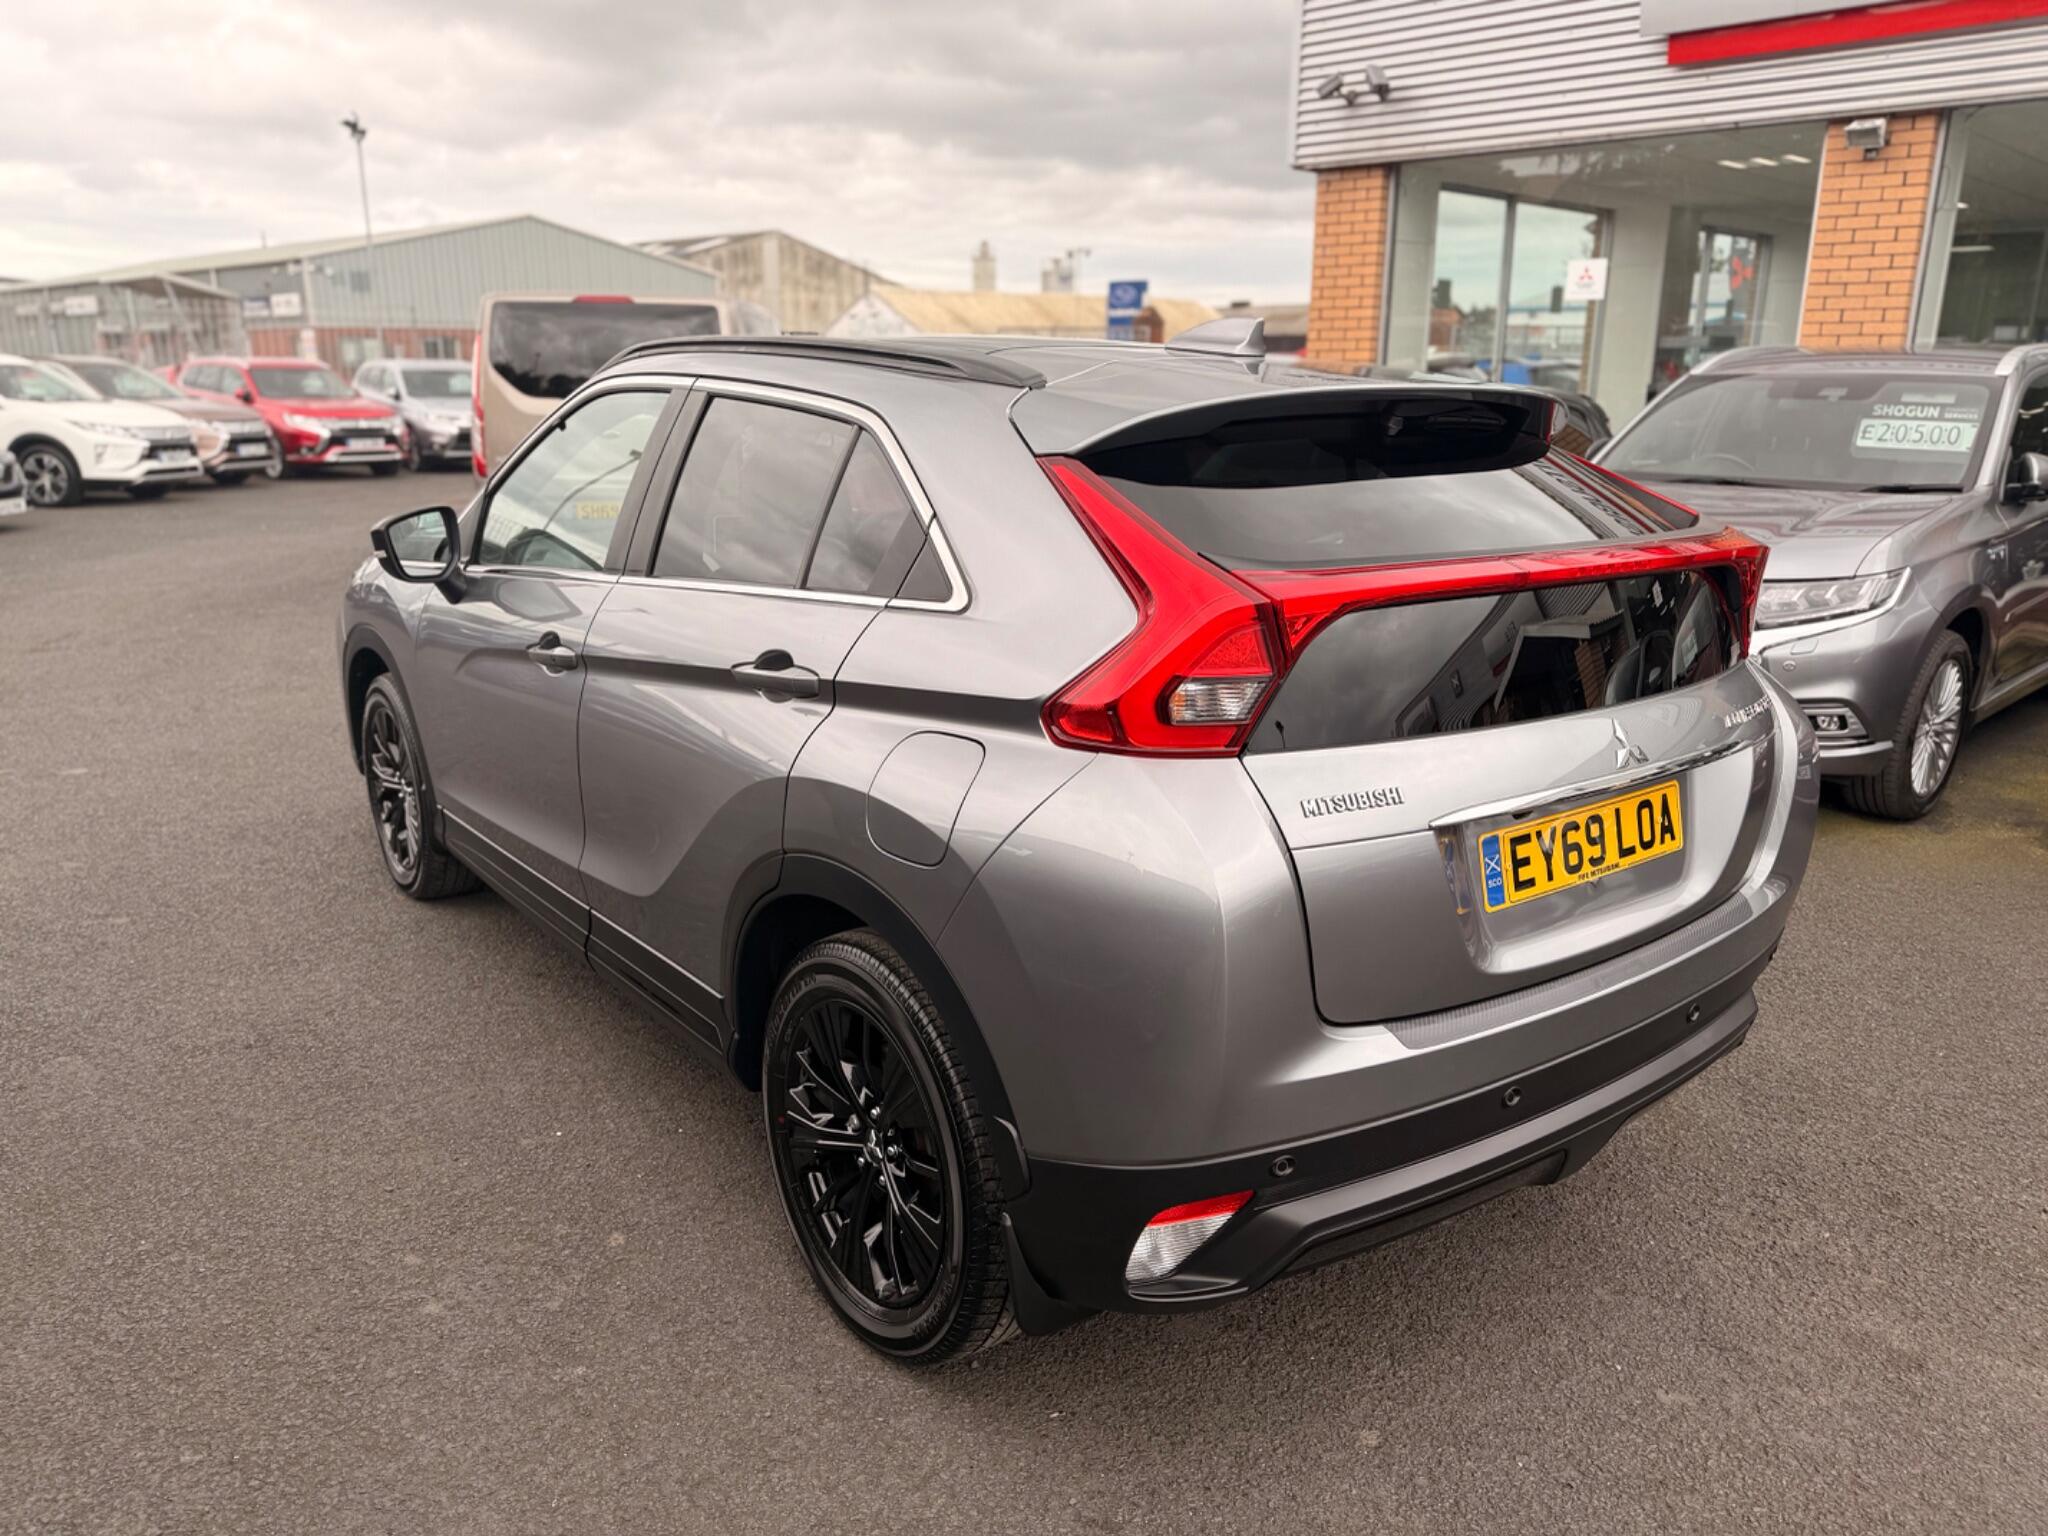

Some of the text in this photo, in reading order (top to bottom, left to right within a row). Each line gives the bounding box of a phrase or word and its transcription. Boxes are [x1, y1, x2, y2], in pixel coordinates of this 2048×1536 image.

[1872, 404, 1940, 418] SHOGUN
[1300, 786, 1405, 818] MITSUBISHI
[1510, 793, 1676, 892] EY69 LOA
[1488, 877, 1503, 889] SCO
